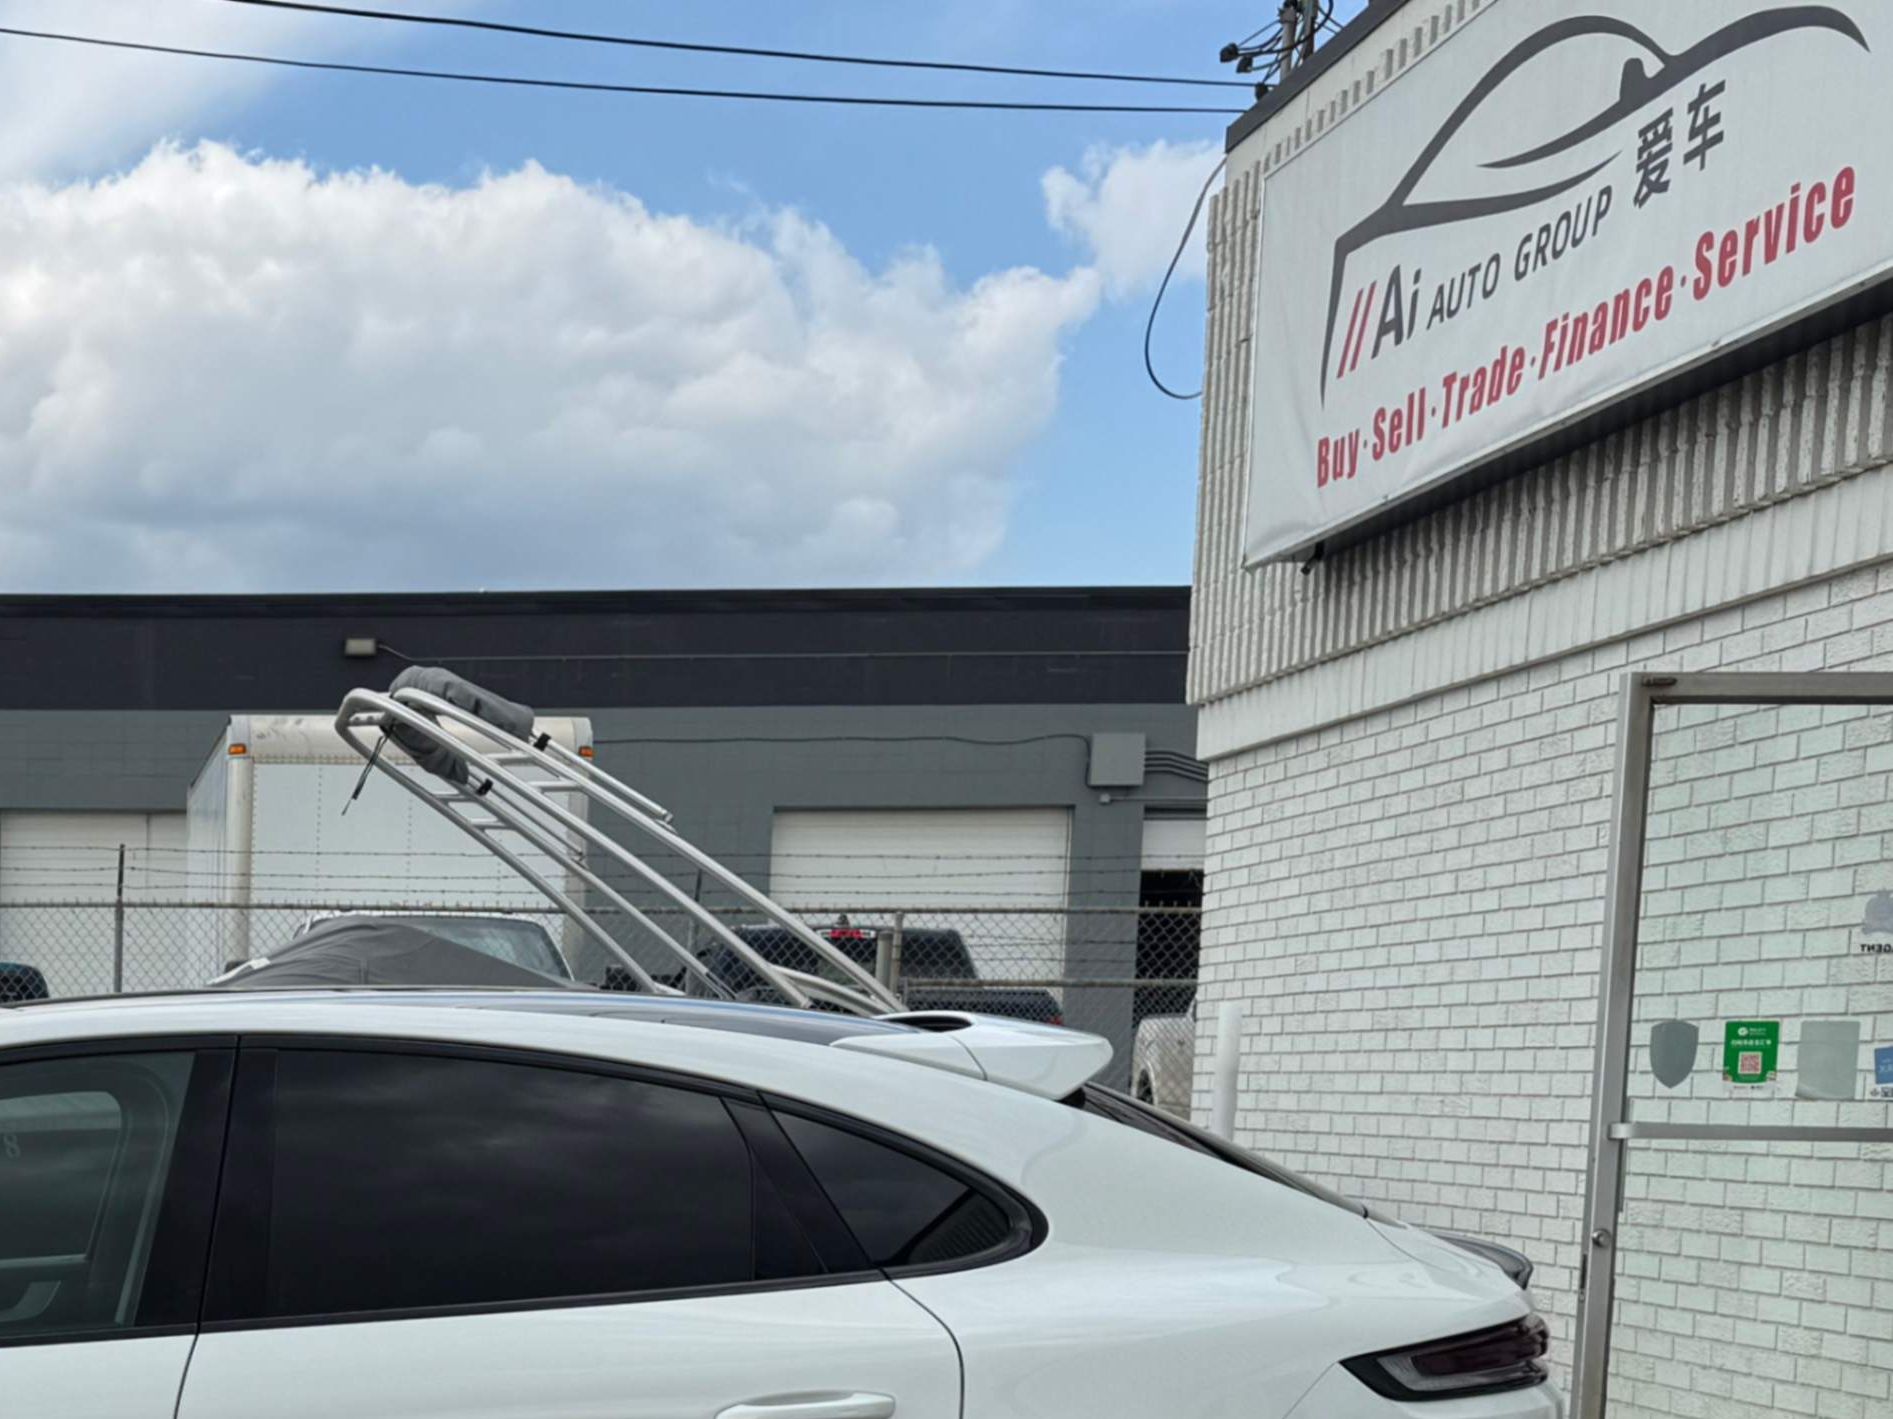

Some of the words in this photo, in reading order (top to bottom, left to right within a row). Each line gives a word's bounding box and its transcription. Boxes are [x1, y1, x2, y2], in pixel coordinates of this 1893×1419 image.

[1425, 252, 1501, 330] AUTO
[1514, 184, 1613, 282] GROUP
[1633, 79, 1726, 209] 爱车
[1692, 165, 1855, 301] Service
